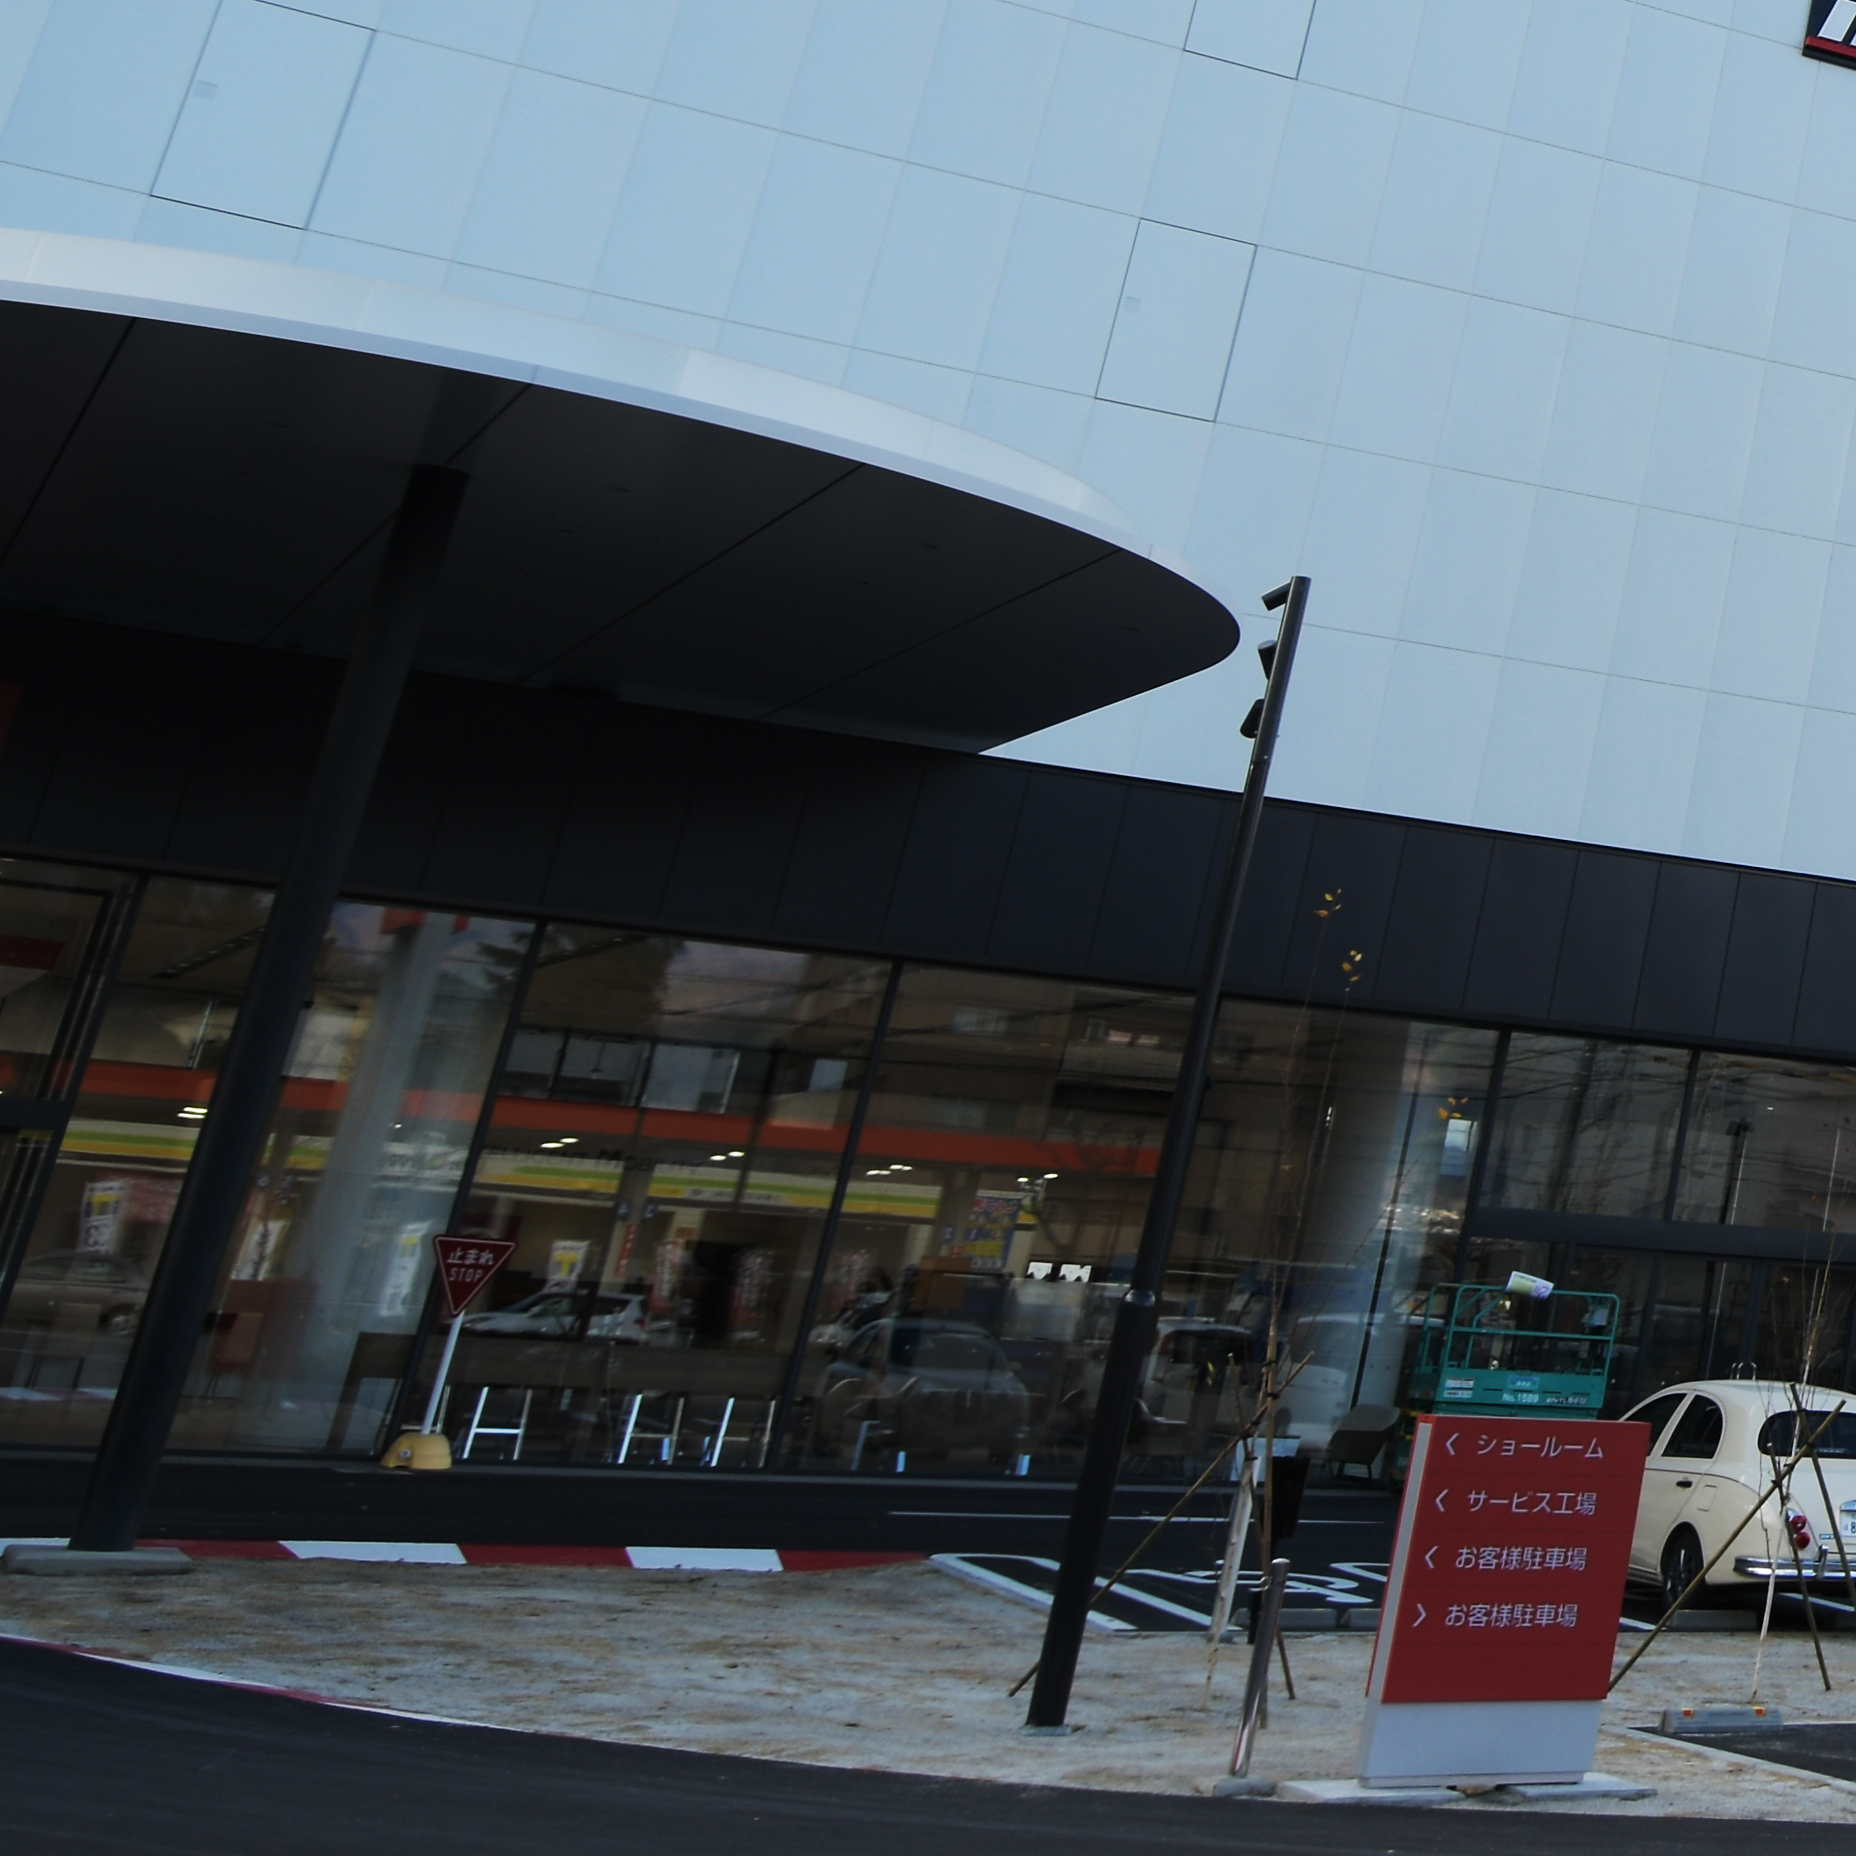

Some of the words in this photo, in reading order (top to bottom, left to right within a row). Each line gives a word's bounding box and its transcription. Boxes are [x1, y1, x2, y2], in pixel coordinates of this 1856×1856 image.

[446, 1247, 494, 1265] 止まれ
[448, 1267, 484, 1282] STOP
[1477, 1434, 1603, 1458] ショールーム
[1468, 1490, 1597, 1515] サービス工場
[1455, 1546, 1588, 1570] お客様駐車場
[1444, 1604, 1578, 1628] お客様駐車場
